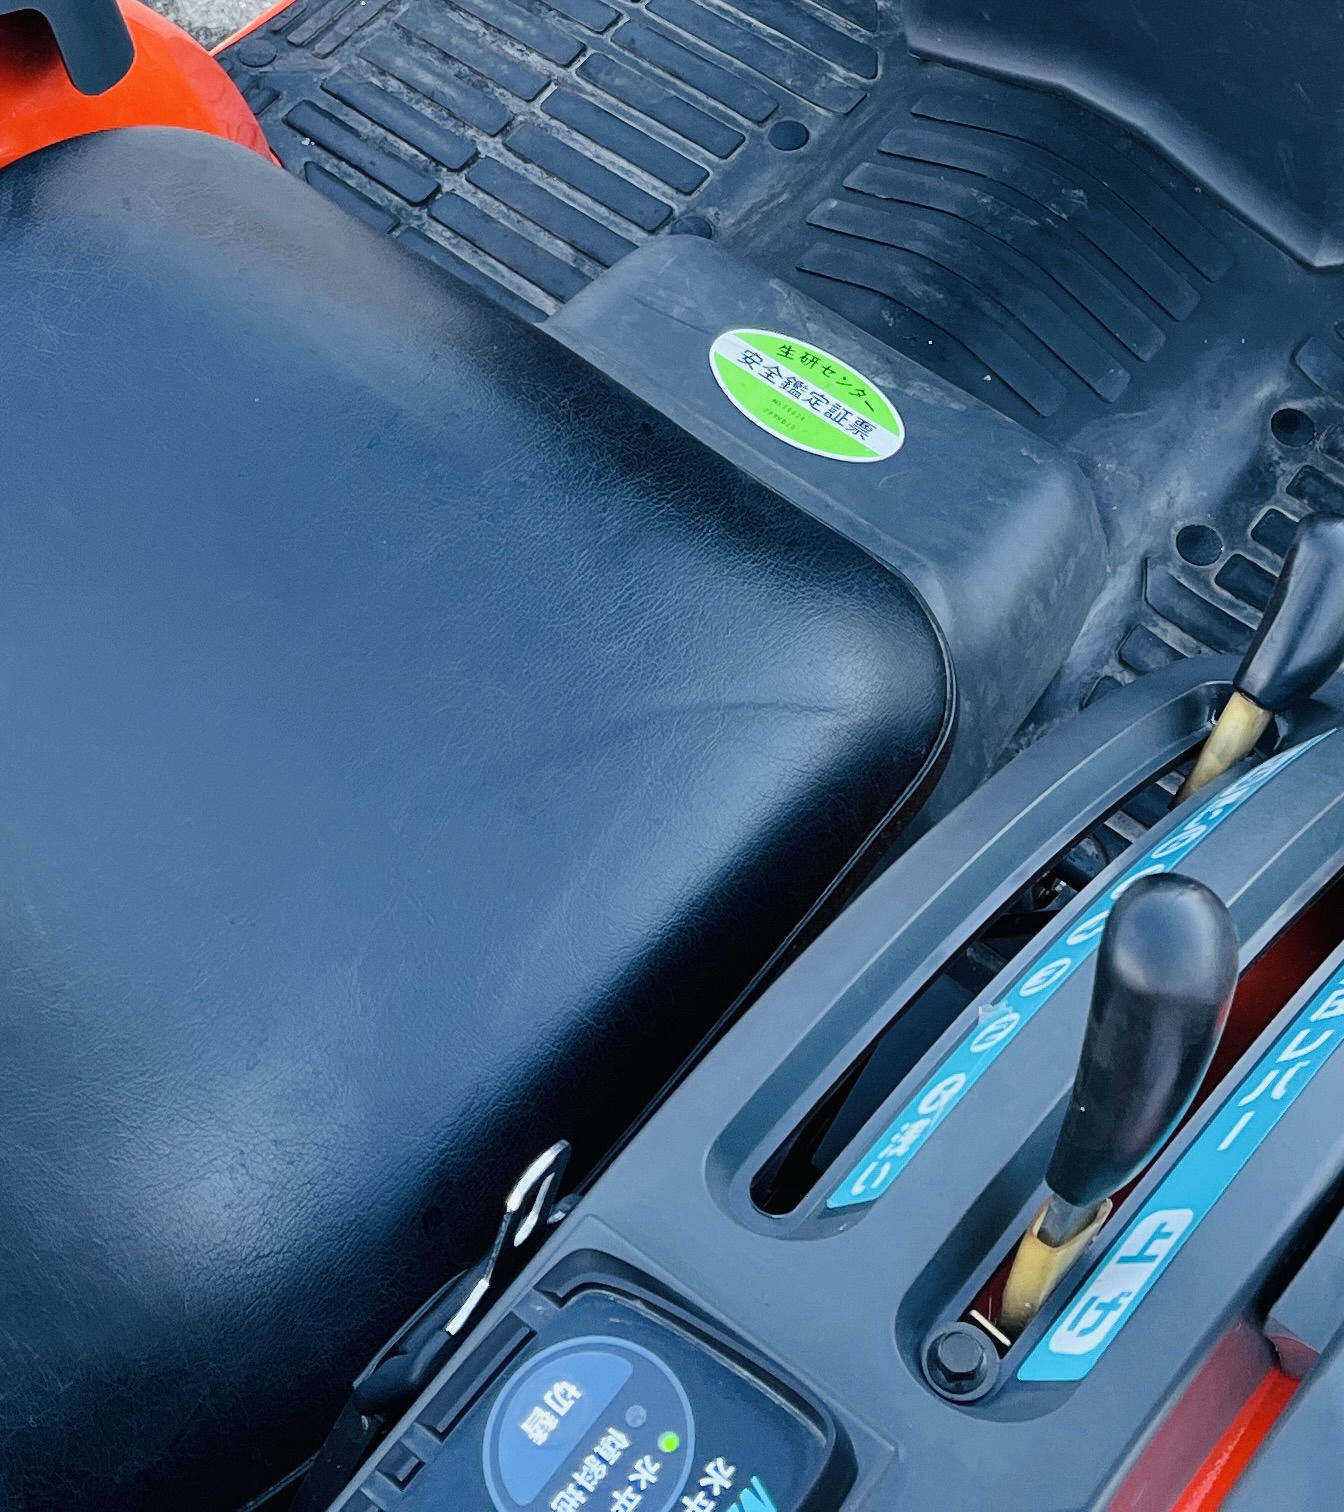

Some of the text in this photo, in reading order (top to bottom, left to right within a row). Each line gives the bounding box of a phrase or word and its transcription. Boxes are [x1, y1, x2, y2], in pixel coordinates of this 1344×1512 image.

[737, 349, 878, 441] 安全鑑定証票
[776, 344, 875, 412] 生研センター
[1066, 1221, 1174, 1338] 上げ
[520, 1380, 583, 1446] 切替
